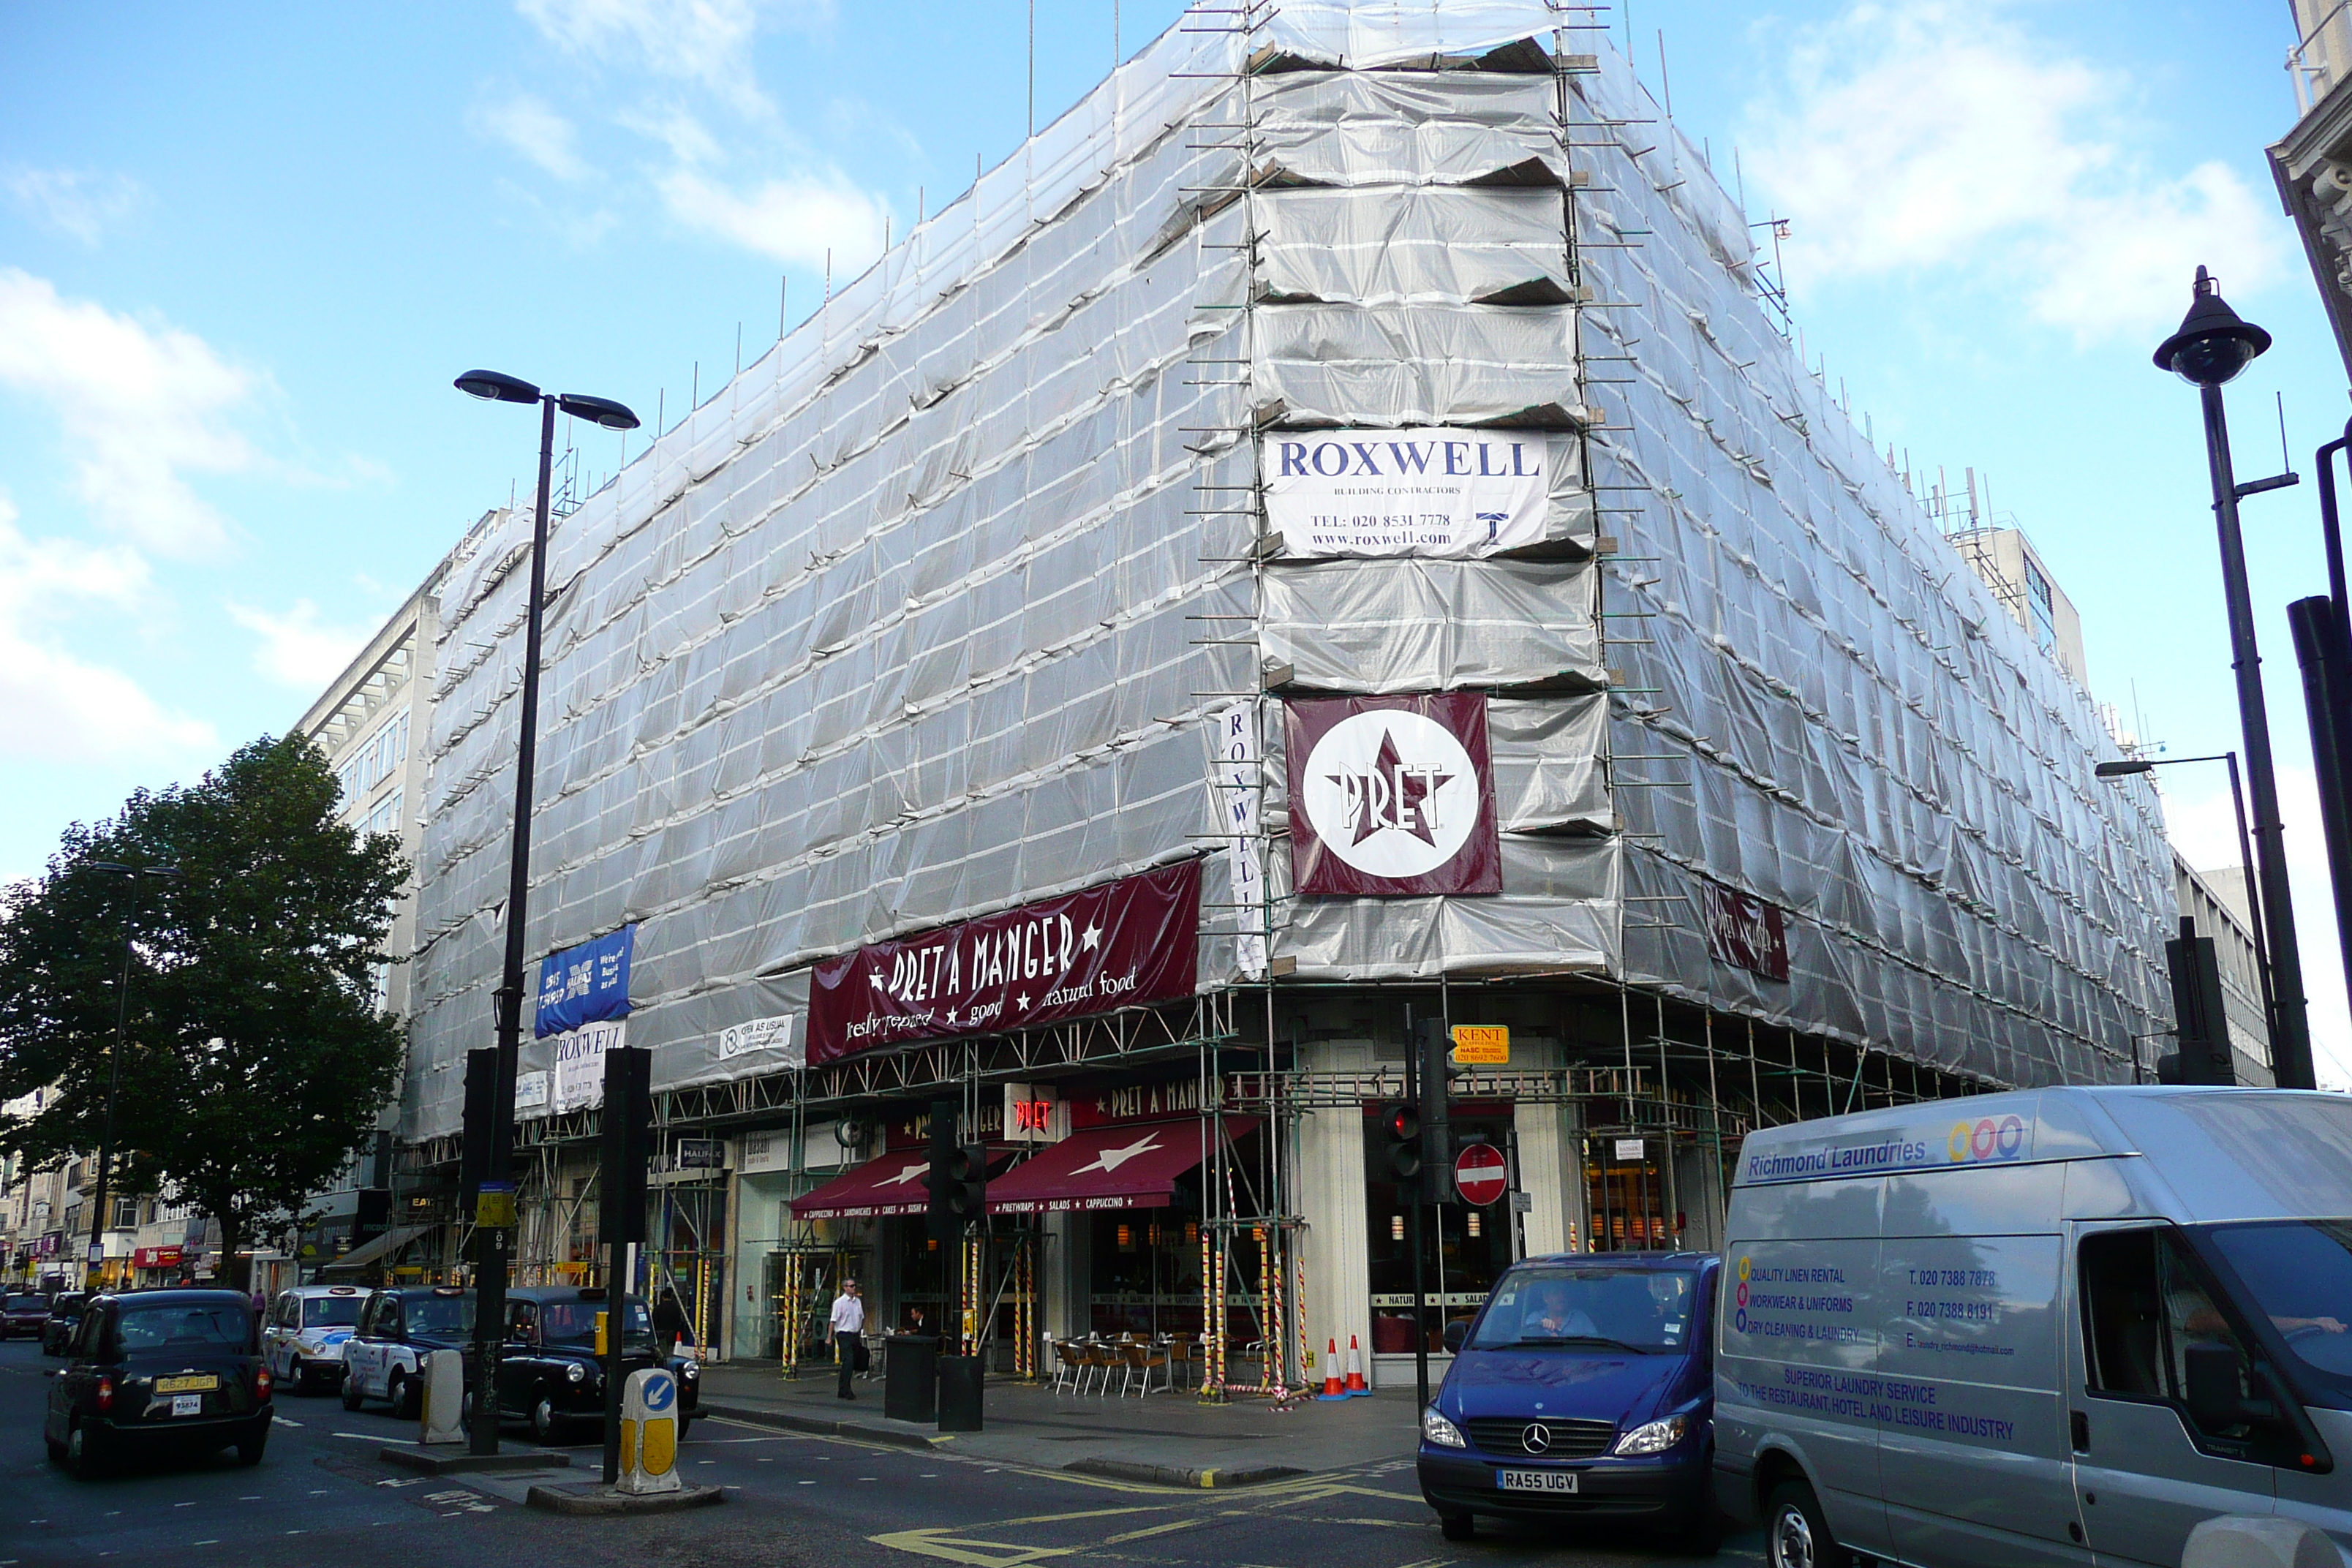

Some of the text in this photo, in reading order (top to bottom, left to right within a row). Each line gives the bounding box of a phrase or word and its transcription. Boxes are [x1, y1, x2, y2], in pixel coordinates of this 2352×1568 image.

[1277, 440, 1540, 476] ROXWELL
[1334, 486, 1461, 495] BUILDING CONTRACTORS
[1311, 513, 1451, 527] TEL: 020 8531 7778
[1313, 530, 1452, 546] www.roxwell.com
[1339, 761, 1441, 829] PRET
[888, 912, 1073, 1001] PRET A MANGER
[1099, 965, 1137, 995] food
[969, 998, 1003, 1025] good
[755, 1022, 765, 1032] AS
[1458, 1029, 1502, 1041] KENT
[1112, 1085, 1142, 1117] PRET
[1150, 1085, 1159, 1114] A
[684, 1150, 721, 1158] HALIFAX
[1748, 1138, 1926, 1177] Richmond Laundries
[809, 1204, 921, 1218] CAPPUCCINO SANDWICHES CAKES SUSHI
[1049, 1199, 1071, 1210] SALADS
[1086, 1196, 1123, 1209] CAPPUCCINO
[1751, 1268, 1845, 1283] QUALITY LINEN RENTAL
[1909, 1270, 1995, 1286] T. 020 7388 7878
[1749, 1294, 1852, 1313] WORKWEAR & UNIFORMS
[1907, 1301, 1992, 1319] F. 020 7388 8191
[1748, 1321, 1859, 1343] DRY CLEANING & LAUNDRY
[1907, 1333, 2015, 1356] E. laundry_richmond@hotmail.com
[1784, 1368, 1936, 1405] SUPERIOR LAUNDRY SERVICE
[1738, 1382, 2013, 1441] TO THE RESTAURANT, HOTEL AND LEISURE INDUSTRY
[2205, 1444, 2239, 1455] TRANSIT
[1505, 1473, 1573, 1490] RA55 UGV
